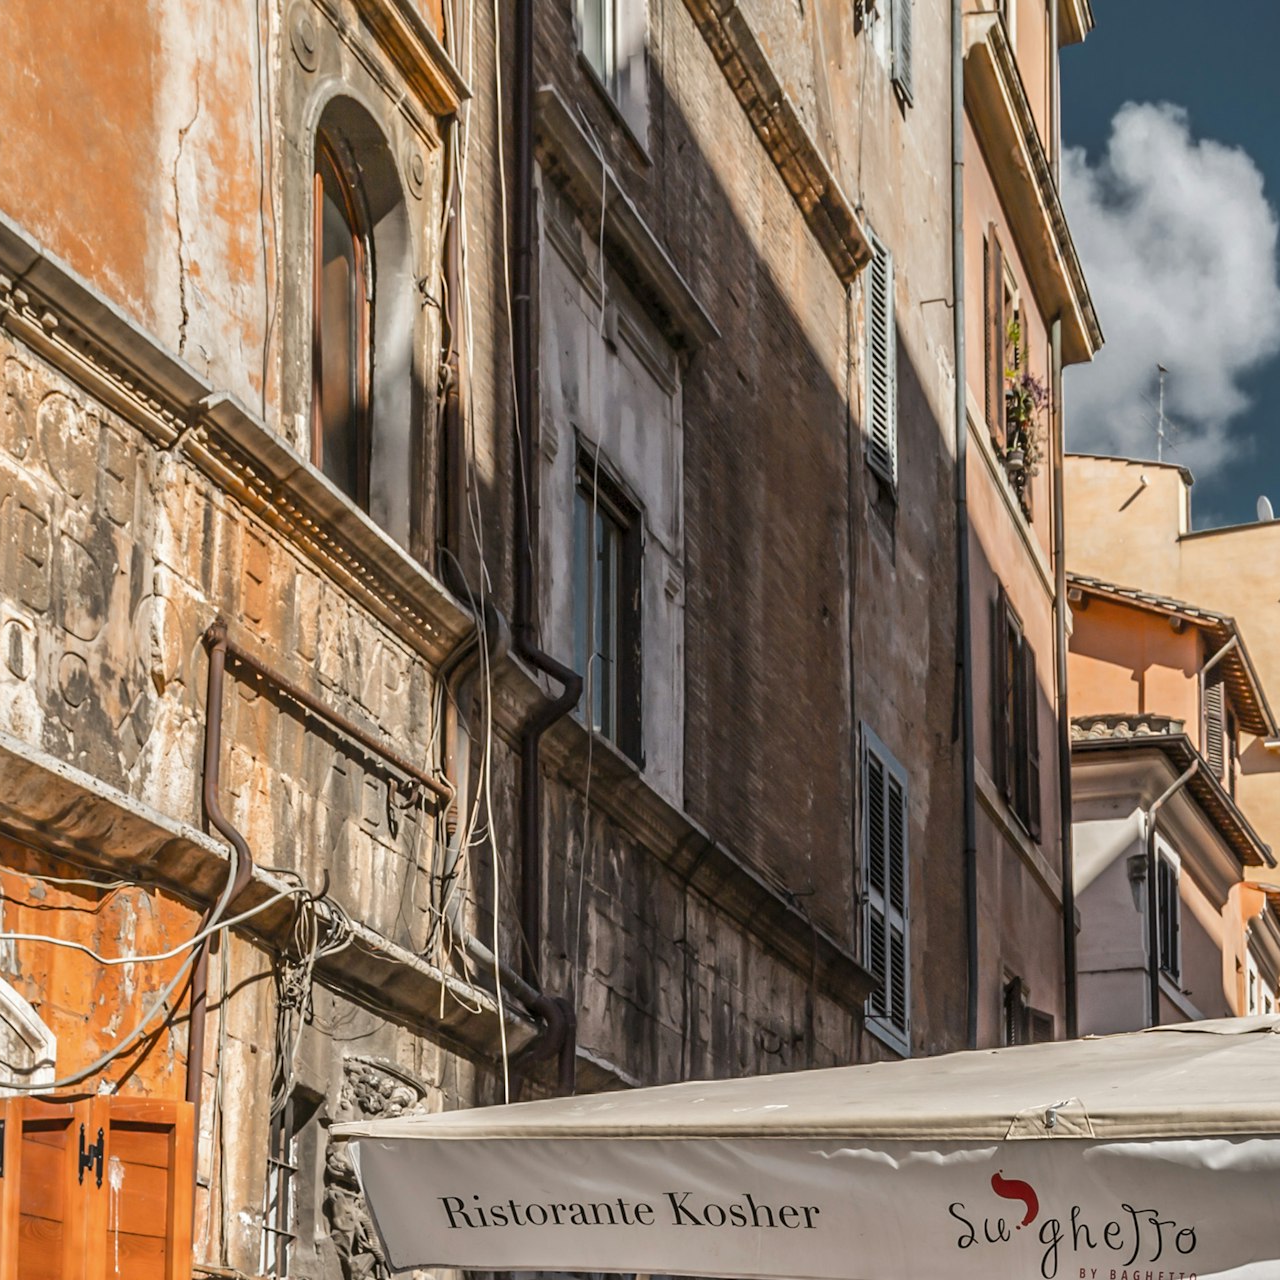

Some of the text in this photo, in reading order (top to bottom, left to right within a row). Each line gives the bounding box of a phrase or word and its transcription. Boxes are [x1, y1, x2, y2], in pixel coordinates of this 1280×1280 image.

[437, 1192, 821, 1230] Ristorante Kosher
[1079, 1267, 1097, 1280] BY
